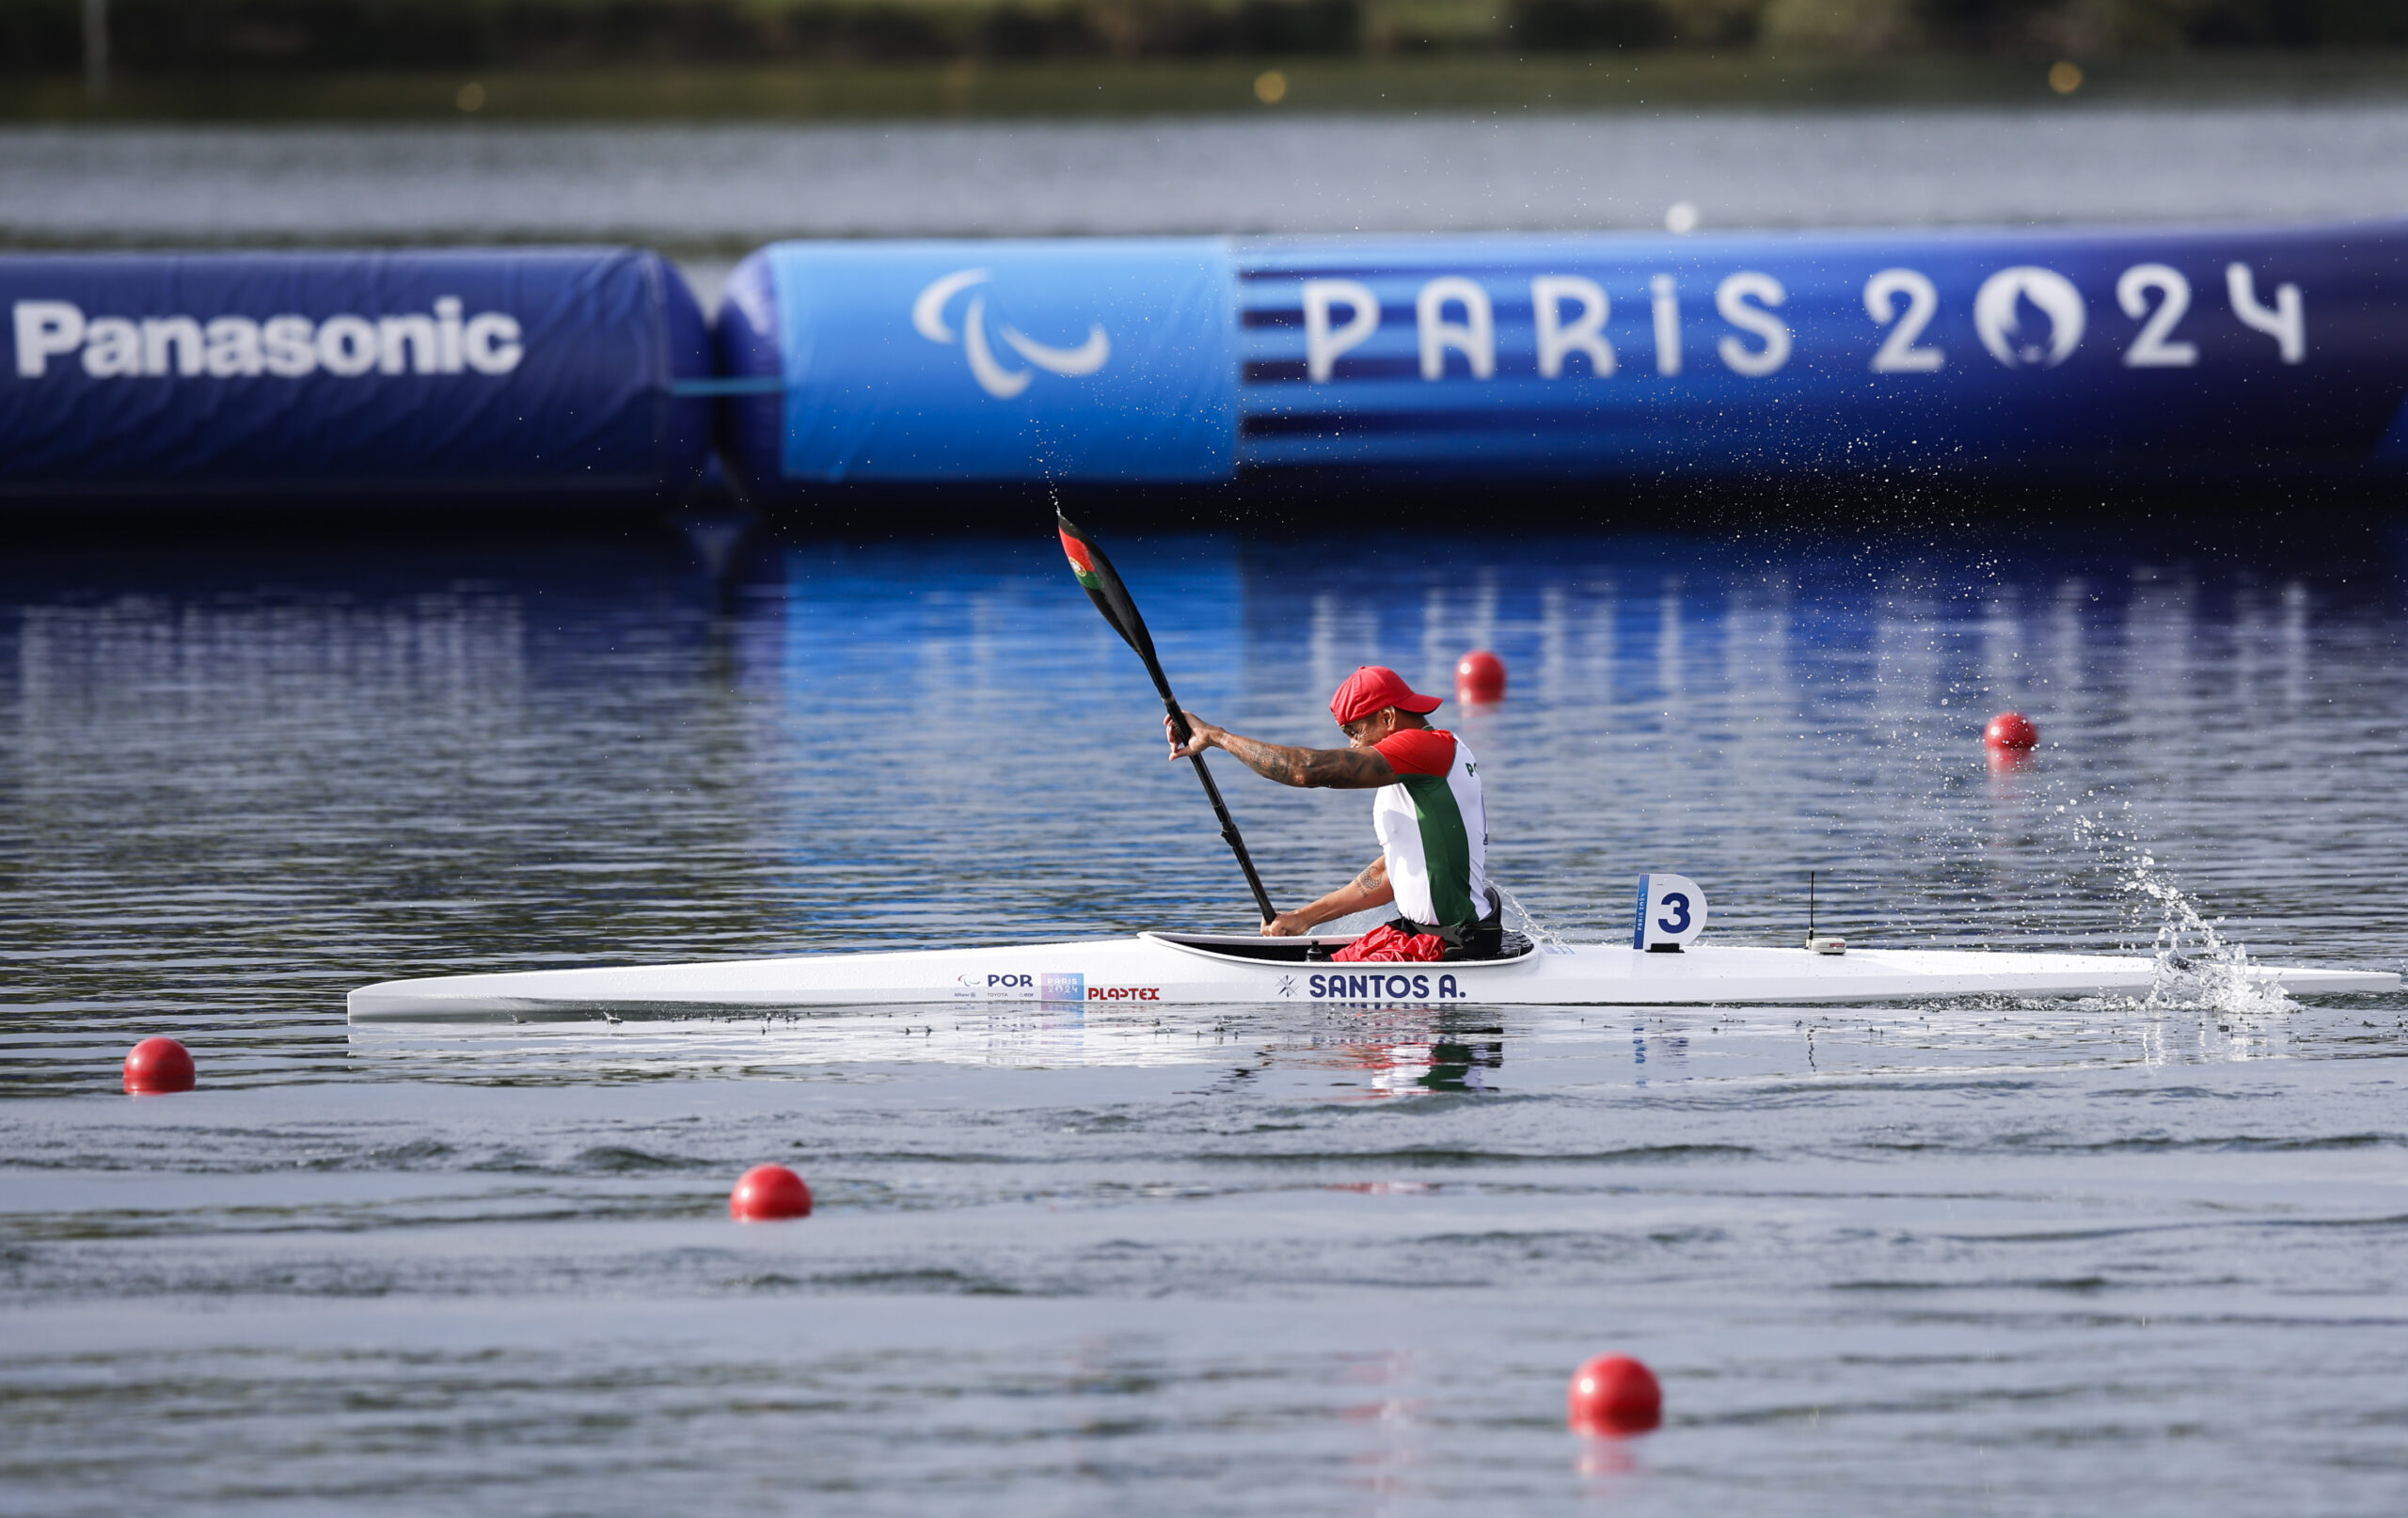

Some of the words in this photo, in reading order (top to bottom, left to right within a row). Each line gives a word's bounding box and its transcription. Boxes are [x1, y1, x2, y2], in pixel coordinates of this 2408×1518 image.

[12, 296, 525, 378] Panasonic
[1302, 271, 1793, 382] PARIS
[1862, 261, 2306, 373] 2024
[1657, 892, 1690, 934] 3
[988, 974, 1034, 988] POR
[1048, 985, 1078, 994] 2024
[1309, 974, 1430, 999] SANTOS
[1439, 974, 1466, 998] A.
